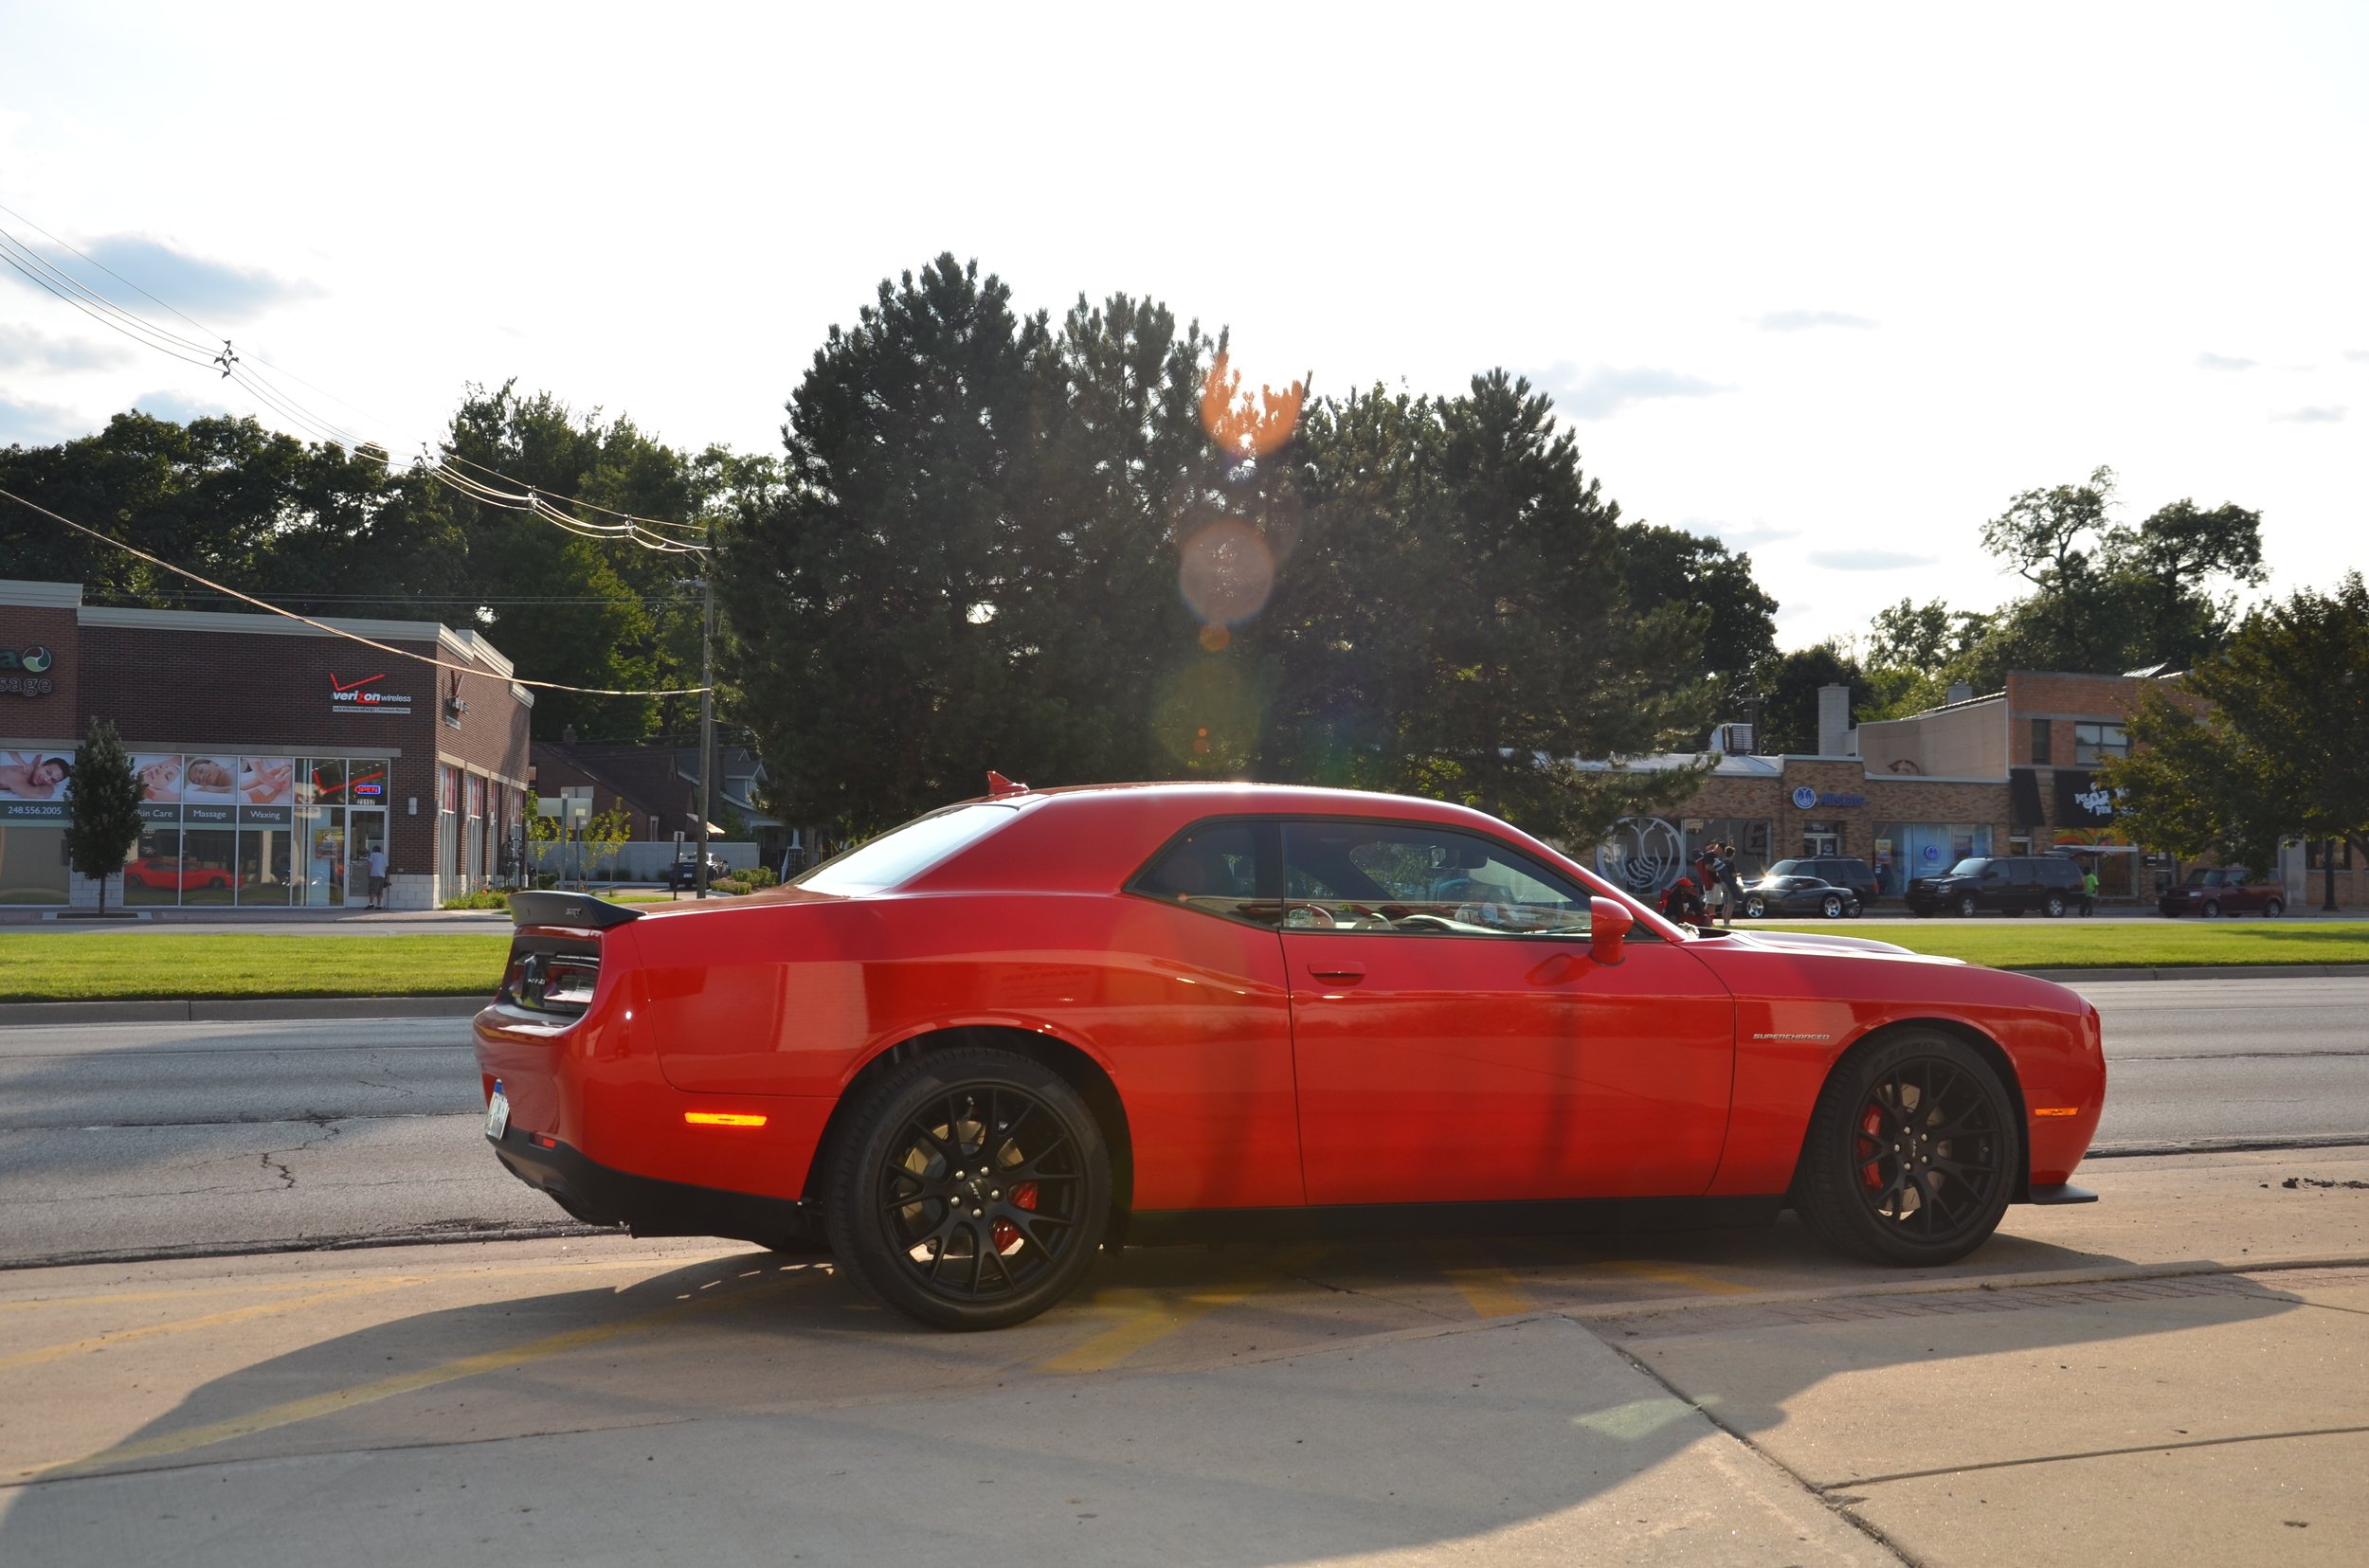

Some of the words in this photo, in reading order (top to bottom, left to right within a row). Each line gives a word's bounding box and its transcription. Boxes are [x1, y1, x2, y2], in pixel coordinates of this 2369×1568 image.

[333, 691, 380, 704] verizon
[8, 806, 63, 815] 248.556.2005
[153, 809, 173, 818] Care
[193, 809, 226, 820] Massage
[250, 810, 280, 820] Waxing
